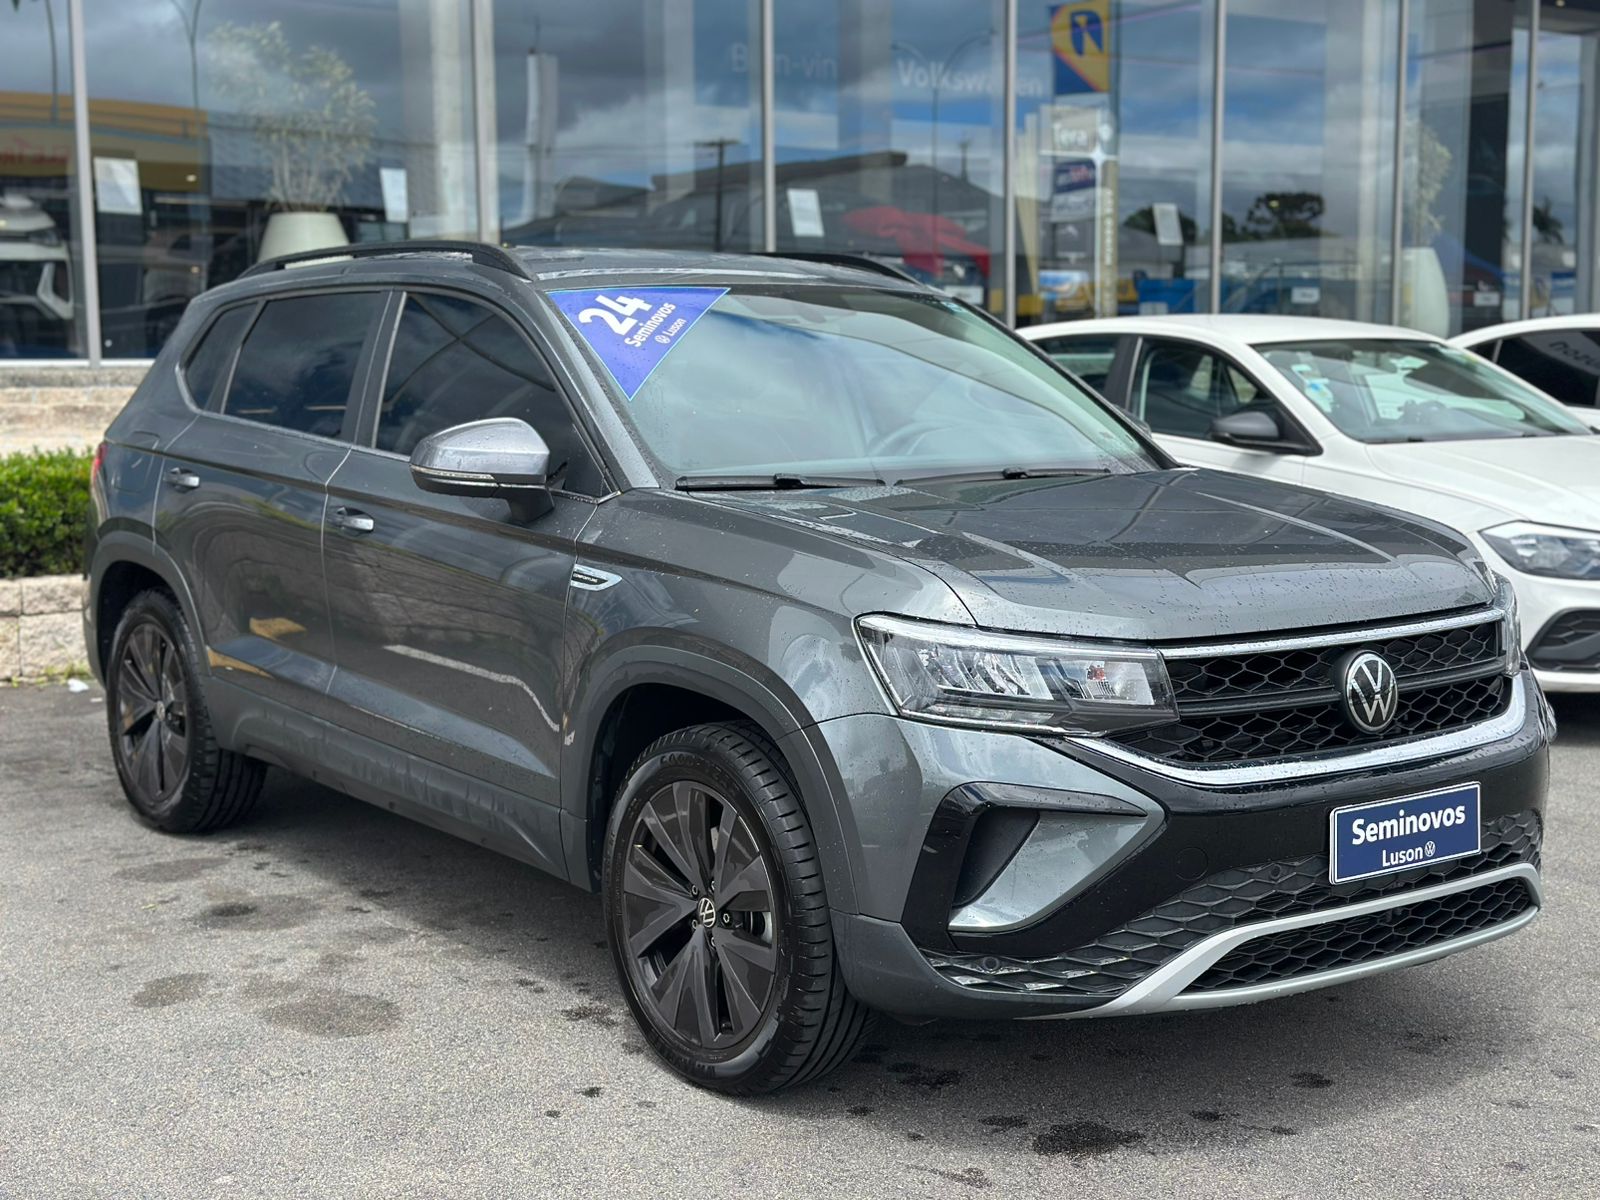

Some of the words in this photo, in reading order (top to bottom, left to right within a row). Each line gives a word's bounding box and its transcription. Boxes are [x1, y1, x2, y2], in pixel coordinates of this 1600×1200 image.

[578, 294, 653, 336] 24
[623, 302, 677, 348] Seminovos
[1352, 805, 1466, 846] Seminovos
[1382, 846, 1423, 868] Luson
